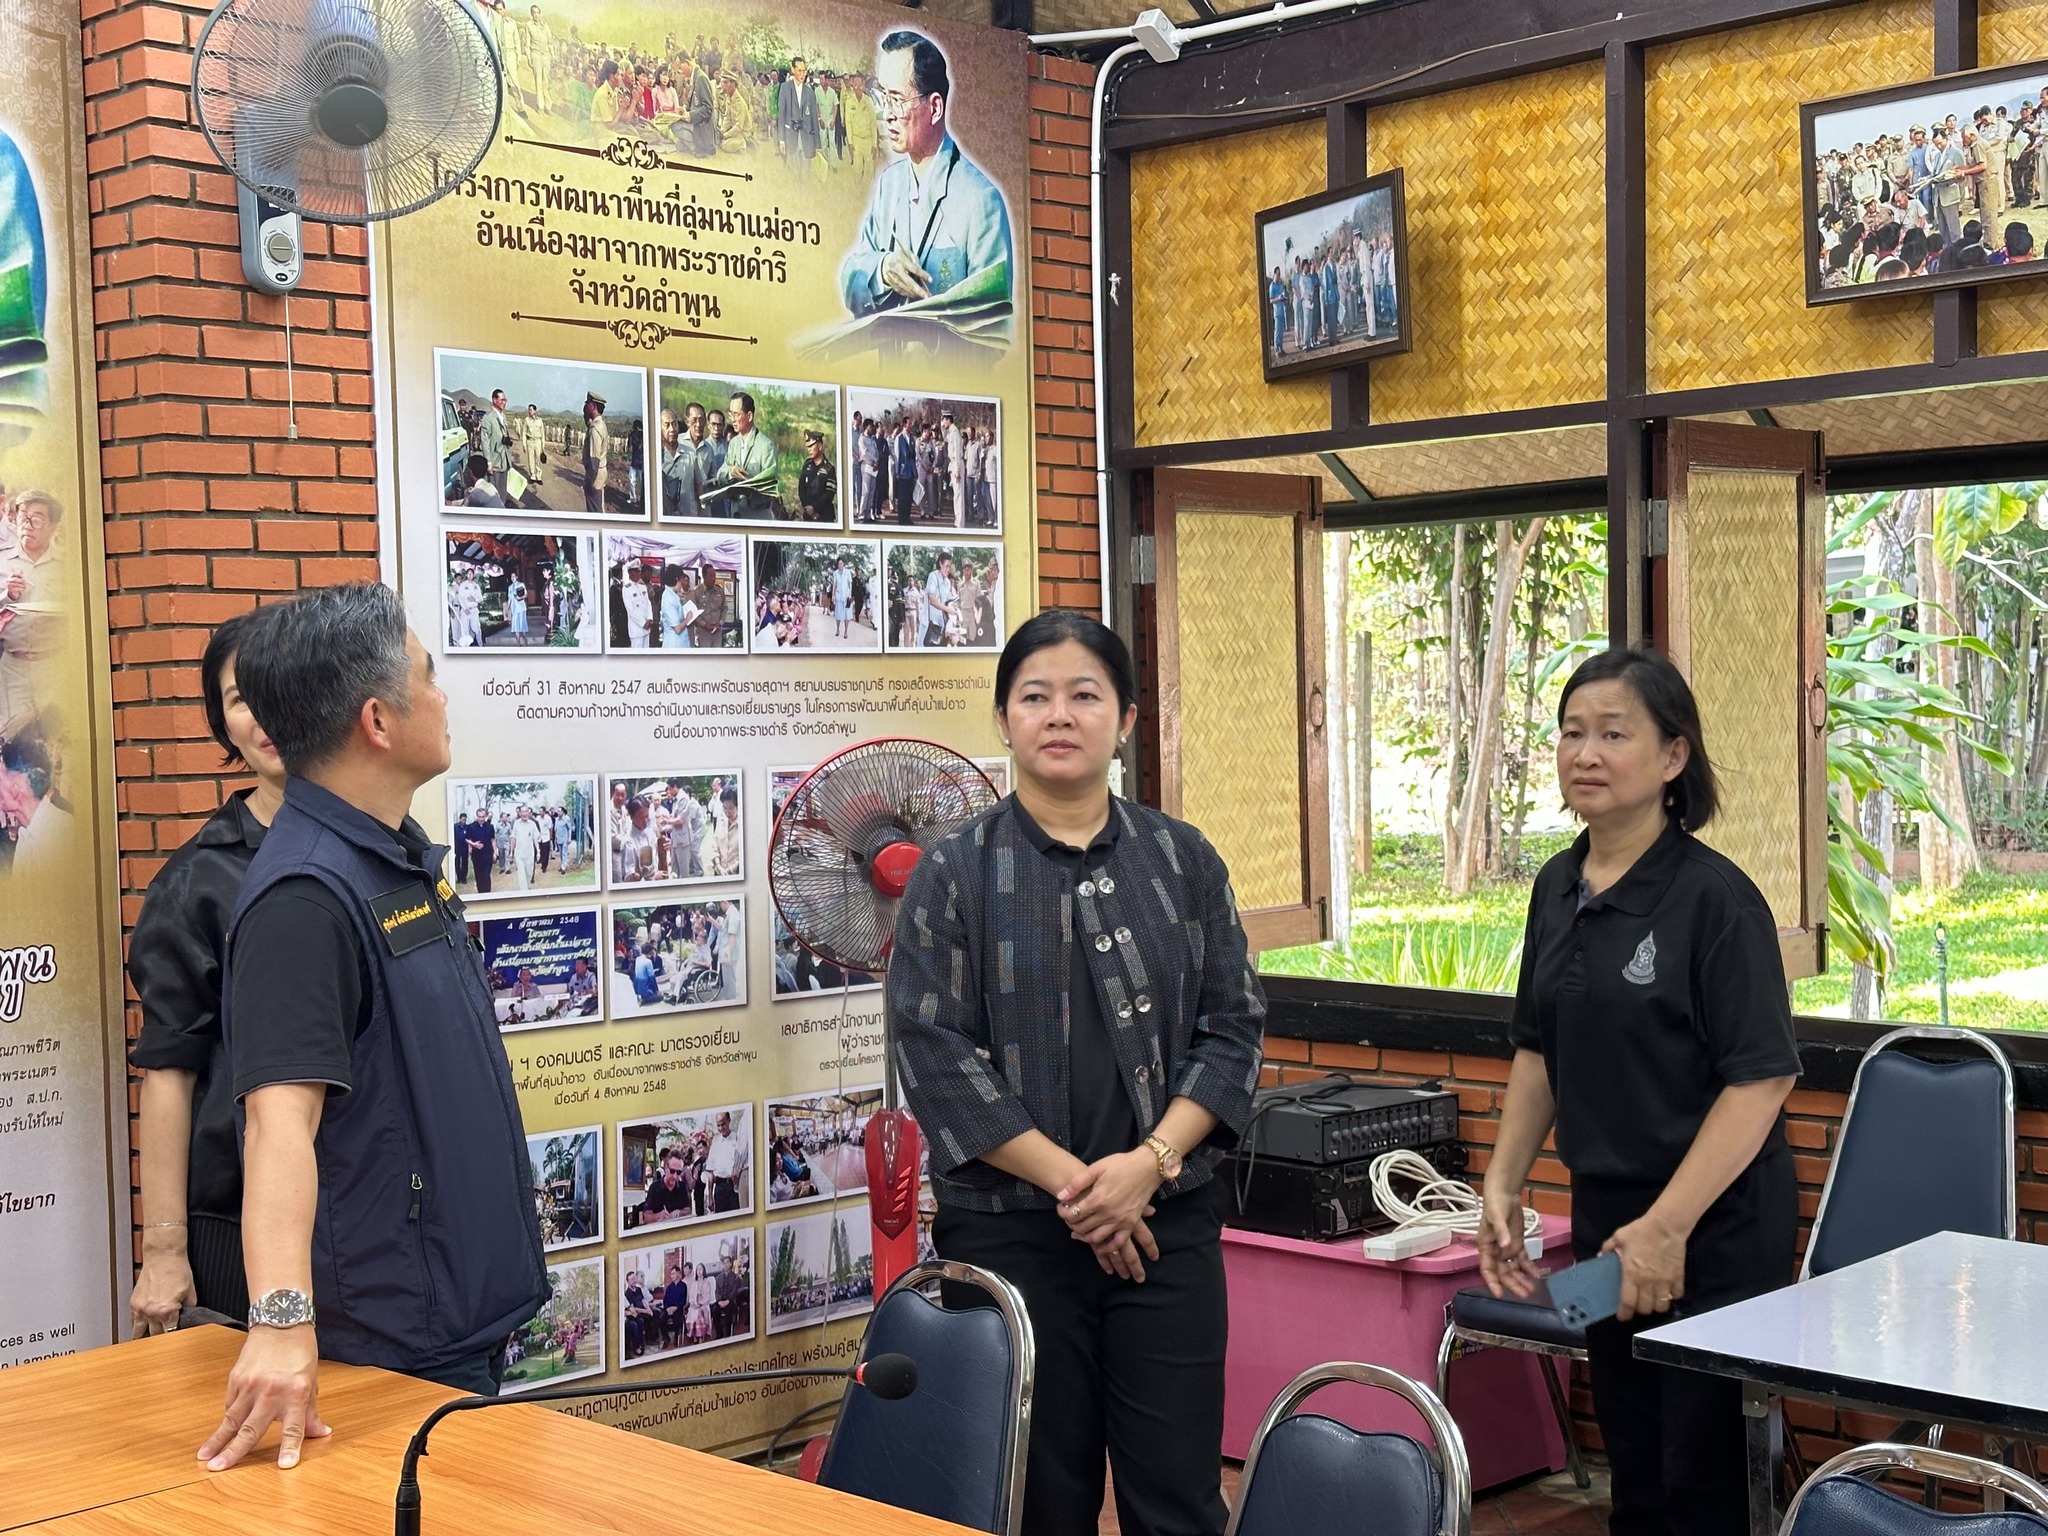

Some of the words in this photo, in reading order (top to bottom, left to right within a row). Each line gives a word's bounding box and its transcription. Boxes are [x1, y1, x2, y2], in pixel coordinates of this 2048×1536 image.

[476, 209, 787, 284] อันเนื่องมาจากพระราชดำริ
[569, 267, 721, 327] จังหวัดลำพูน
[482, 677, 531, 696] เมื่อวันที่
[536, 680, 552, 696] 31
[558, 679, 606, 696] สิงหาคม
[610, 679, 641, 695] 2547
[646, 677, 789, 697] สมเด็จพระเทพรัตนราชสุดาฯ
[793, 676, 884, 695] สยามบรมราชกุมารี
[888, 675, 991, 691] ทรงเสด็จพระราชดำเนิน
[653, 721, 788, 739] อันเนื่องมาจากพระราชดำริ
[793, 721, 857, 737] จังหวัดลำพูน
[536, 1044, 602, 1069] องคมนตรี
[609, 1042, 655, 1061] และคณะ
[660, 1026, 740, 1053] มาตรวจเยี่ยม
[705, 1050, 757, 1068] จังหวัดลำพูน
[0, 1065, 57, 1082] พระเนตร
[554, 1087, 589, 1106] เมื่อวันที่
[594, 1089, 600, 1100] 4
[604, 1083, 639, 1099] สิงหาคม
[643, 1079, 666, 1093] 2548
[0, 1110, 64, 1133] งรับให้ใหม่
[29, 1331, 44, 1343] as
[50, 1323, 75, 1338] well
